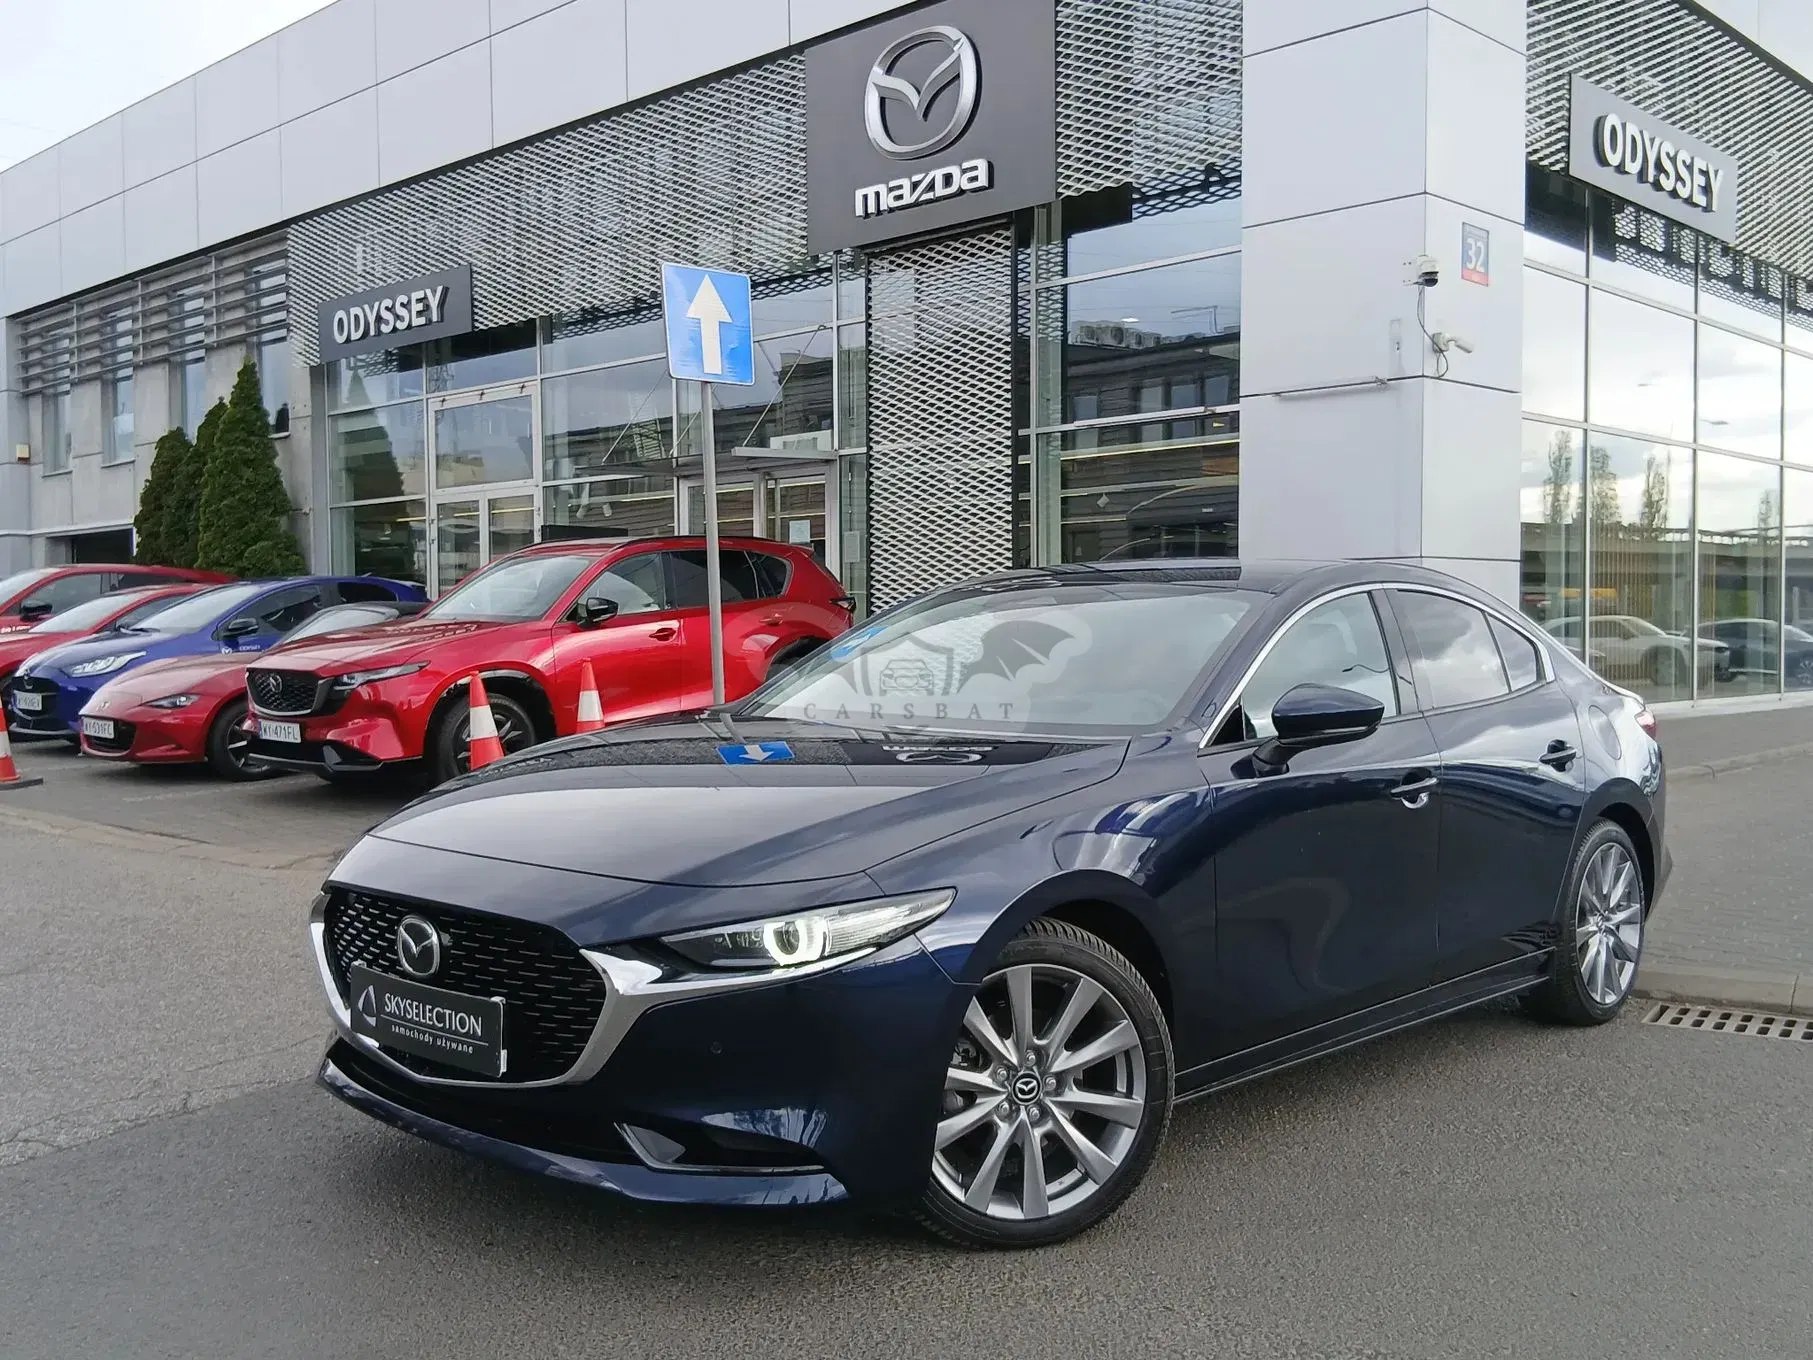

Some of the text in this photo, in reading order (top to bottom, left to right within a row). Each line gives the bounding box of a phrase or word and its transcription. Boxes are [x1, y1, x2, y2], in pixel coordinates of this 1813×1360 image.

[854, 158, 990, 217] mazda
[1602, 113, 1724, 212] ODYSSEY
[1466, 237, 1486, 273] 32
[333, 285, 445, 344] ODYSSEY
[384, 992, 482, 1036] SKYSELECTION
[391, 1024, 474, 1054] samochody używane
